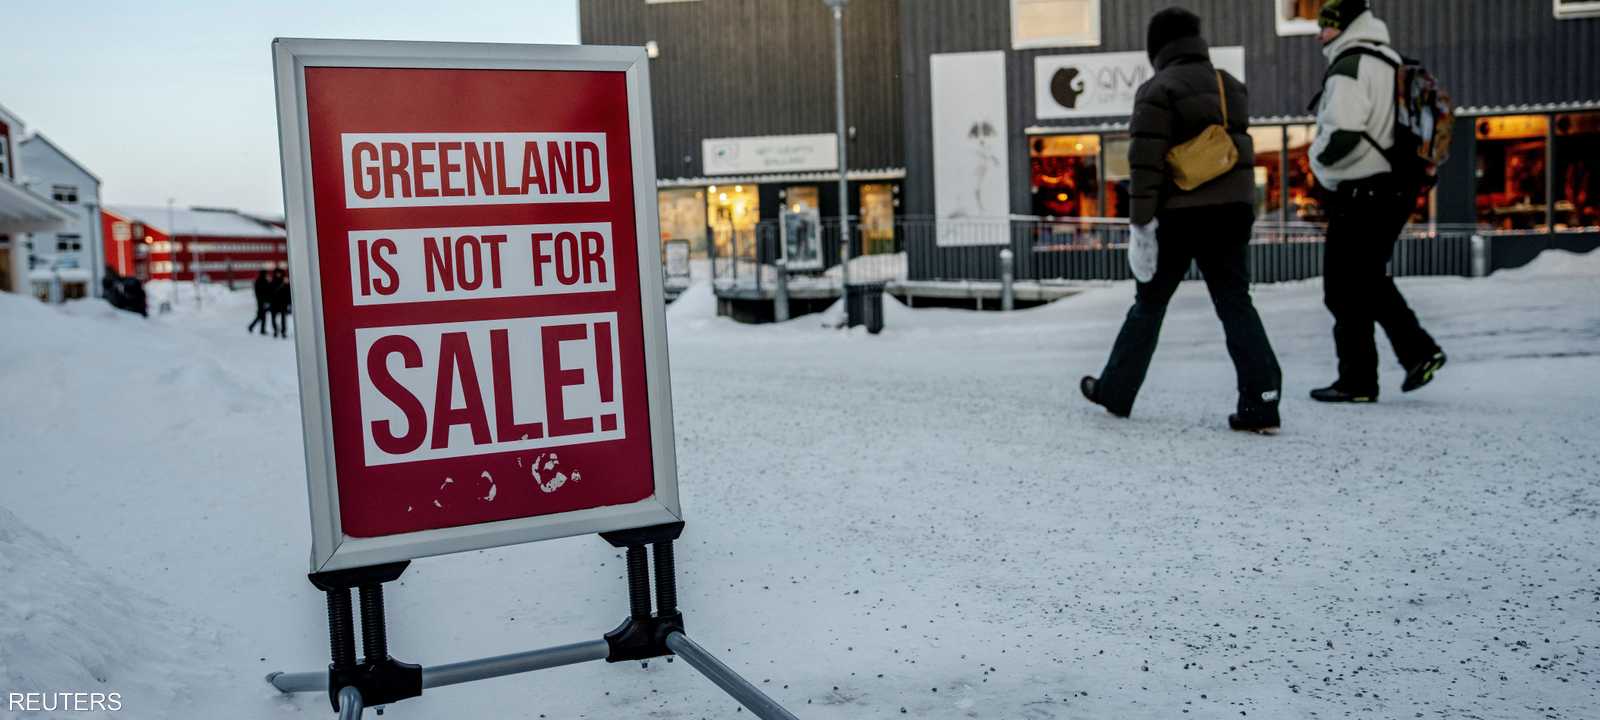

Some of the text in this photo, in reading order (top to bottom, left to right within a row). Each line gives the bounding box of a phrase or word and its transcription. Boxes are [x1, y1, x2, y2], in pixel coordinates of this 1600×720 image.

[351, 140, 602, 200] GREENLAND
[357, 230, 607, 296] IS NOT FOR
[366, 321, 617, 456] SALE!
